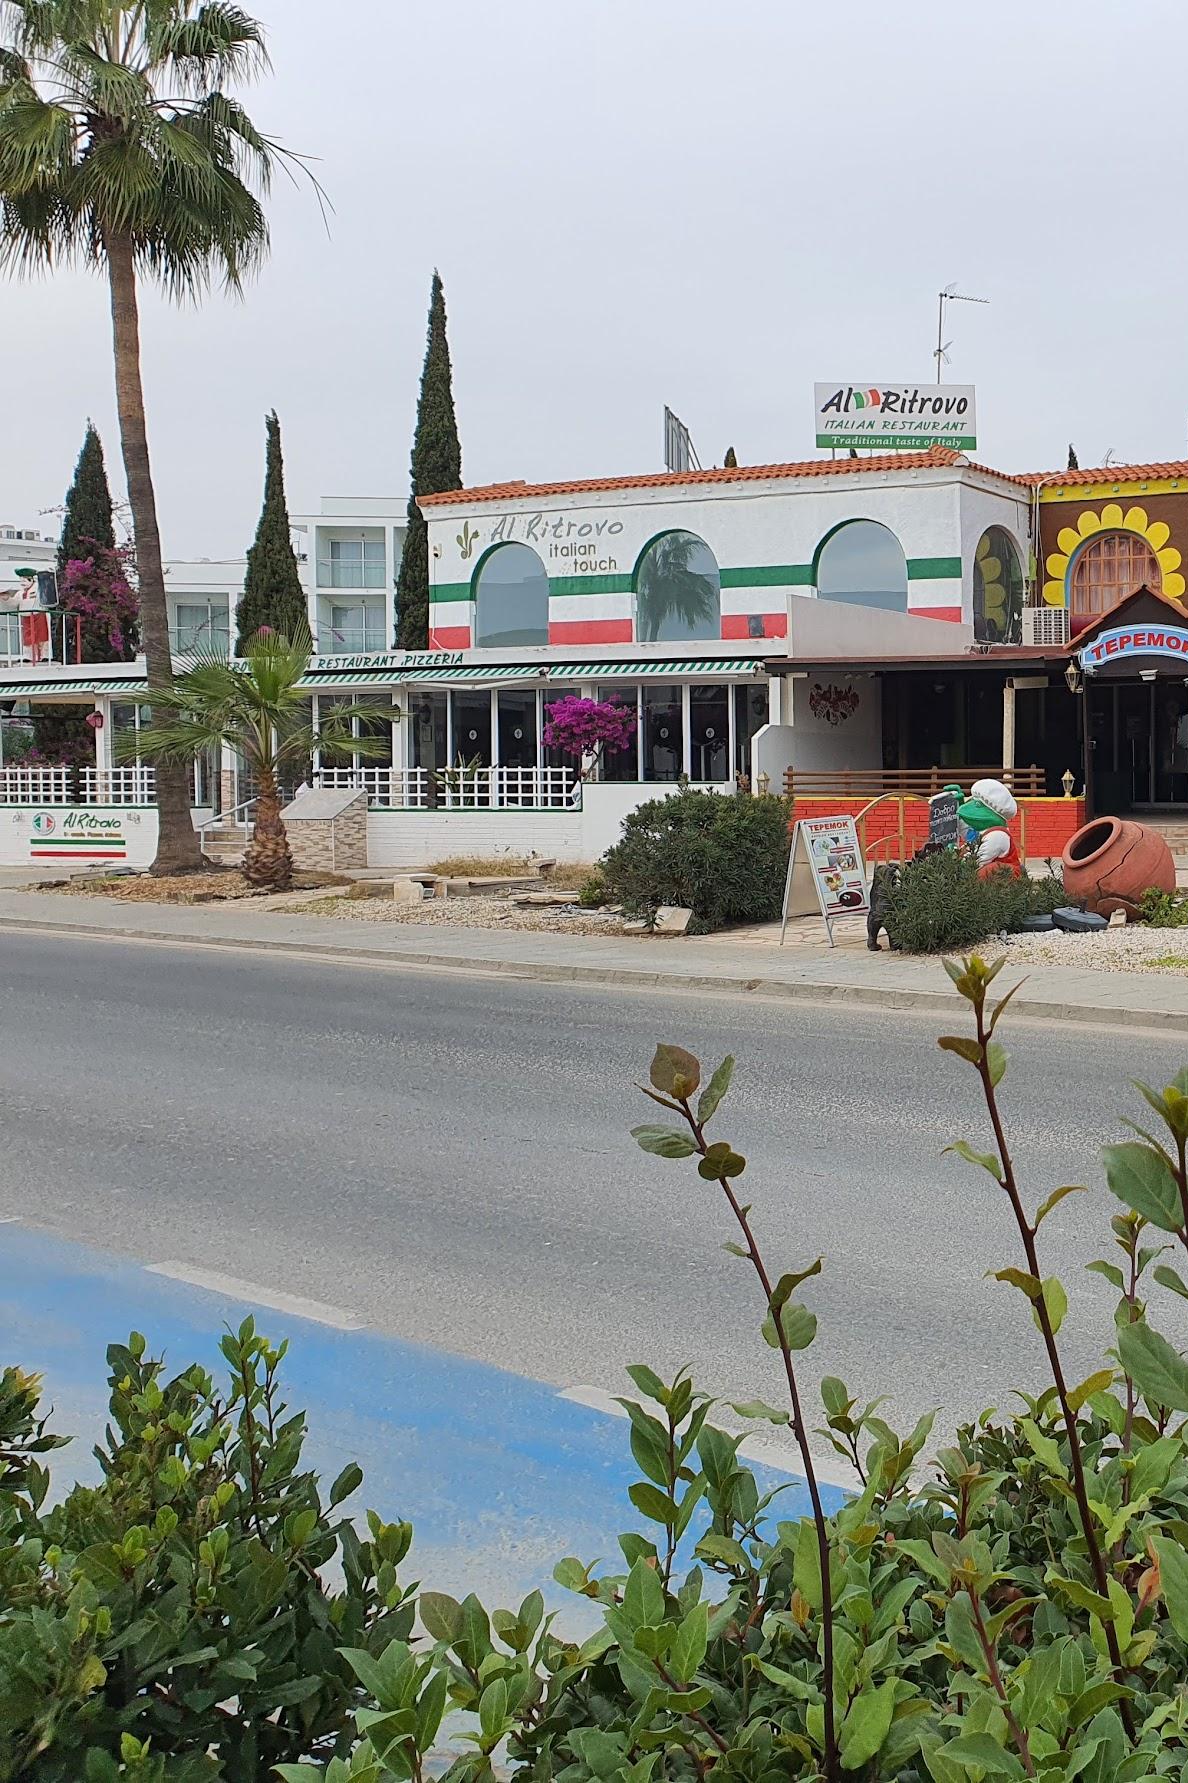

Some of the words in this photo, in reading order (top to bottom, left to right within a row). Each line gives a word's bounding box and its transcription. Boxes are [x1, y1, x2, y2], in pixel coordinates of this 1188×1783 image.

[820, 387, 853, 413] Al
[880, 389, 968, 415] Ritrovo
[825, 419, 876, 430] ITALIAN
[882, 420, 968, 431] RESTAURANT
[831, 436, 893, 445] Traditional
[895, 437, 921, 446] taste
[923, 438, 935, 446] of
[937, 438, 962, 449] Italy
[491, 516, 516, 542] Al
[526, 513, 624, 542] Ritrovo
[549, 542, 597, 558] italian
[573, 556, 617, 572] touch
[317, 655, 398, 669] RESTAURANT
[404, 652, 464, 666] PIZZERIA
[808, 821, 849, 831] ТЕРЕМОК
